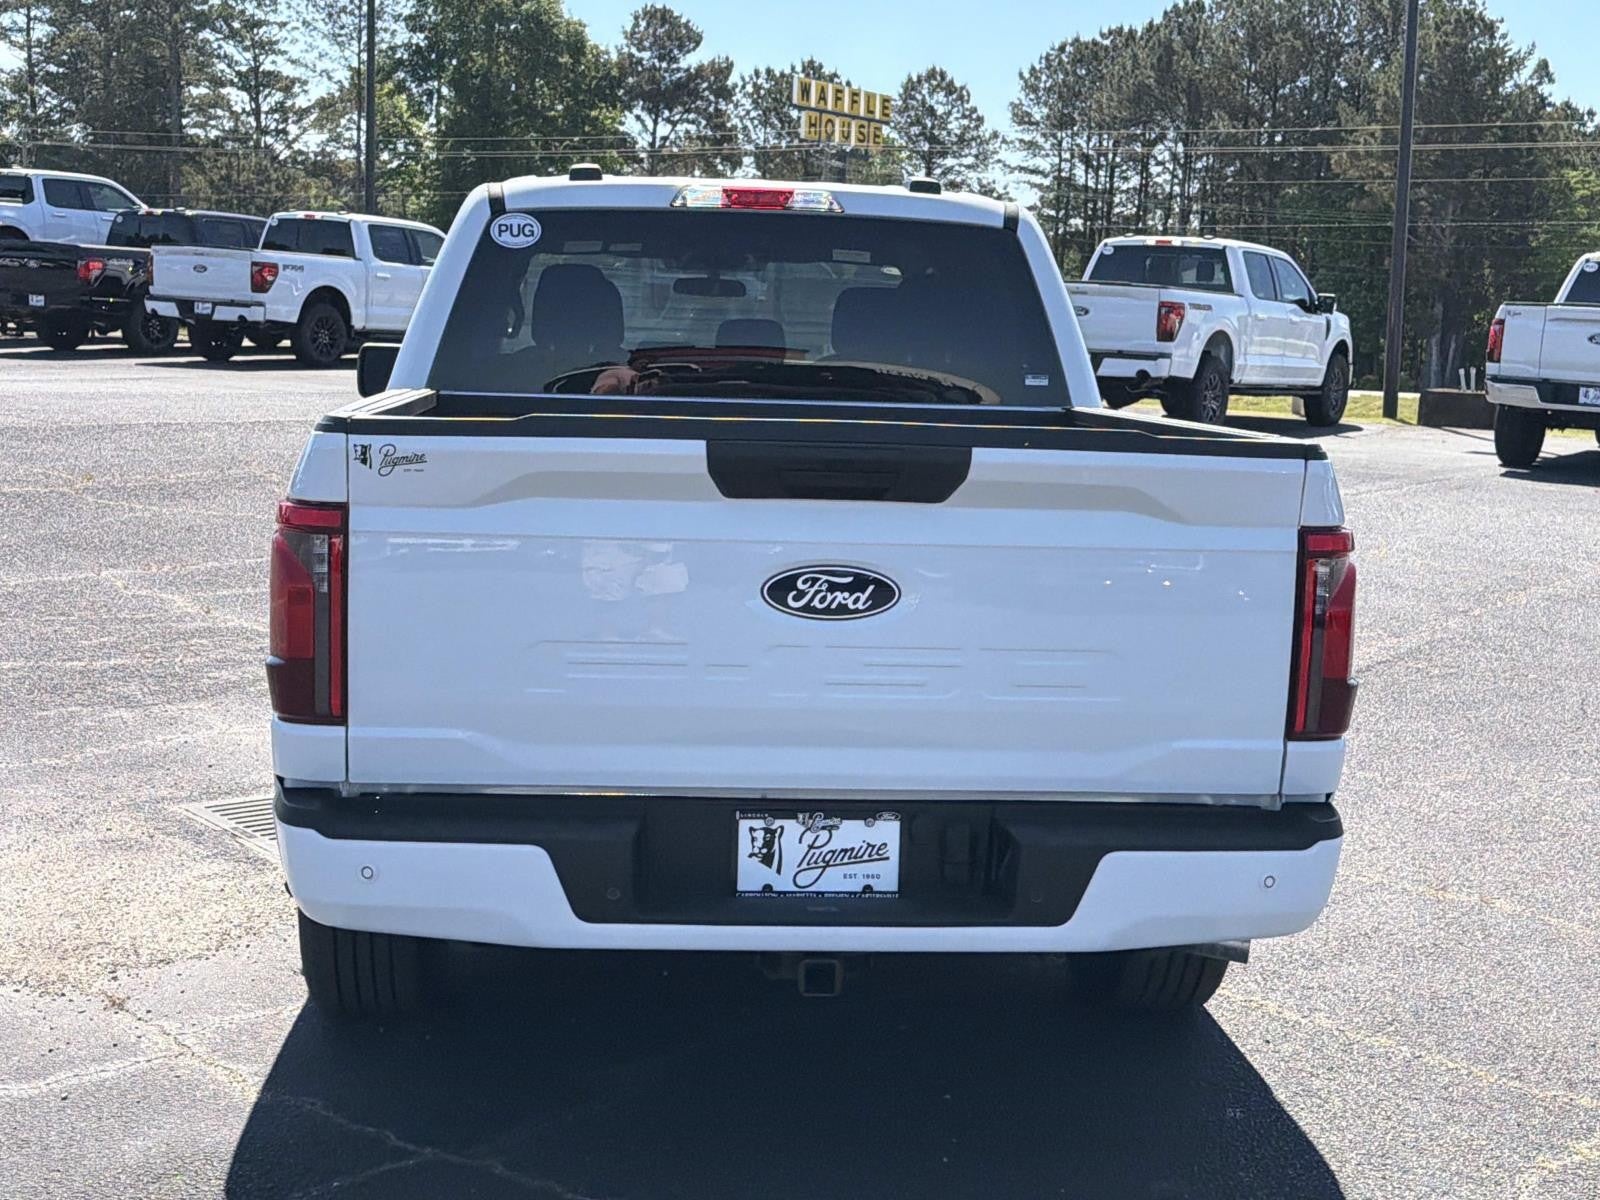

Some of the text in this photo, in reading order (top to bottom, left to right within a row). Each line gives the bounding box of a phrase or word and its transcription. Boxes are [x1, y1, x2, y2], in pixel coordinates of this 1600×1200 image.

[800, 80, 891, 117] WAFFLE
[808, 115, 882, 144] HOUSE
[497, 223, 535, 238] PUG
[378, 443, 428, 477] Pugmire
[787, 573, 876, 610] Ford
[792, 827, 890, 889] Pugmire
